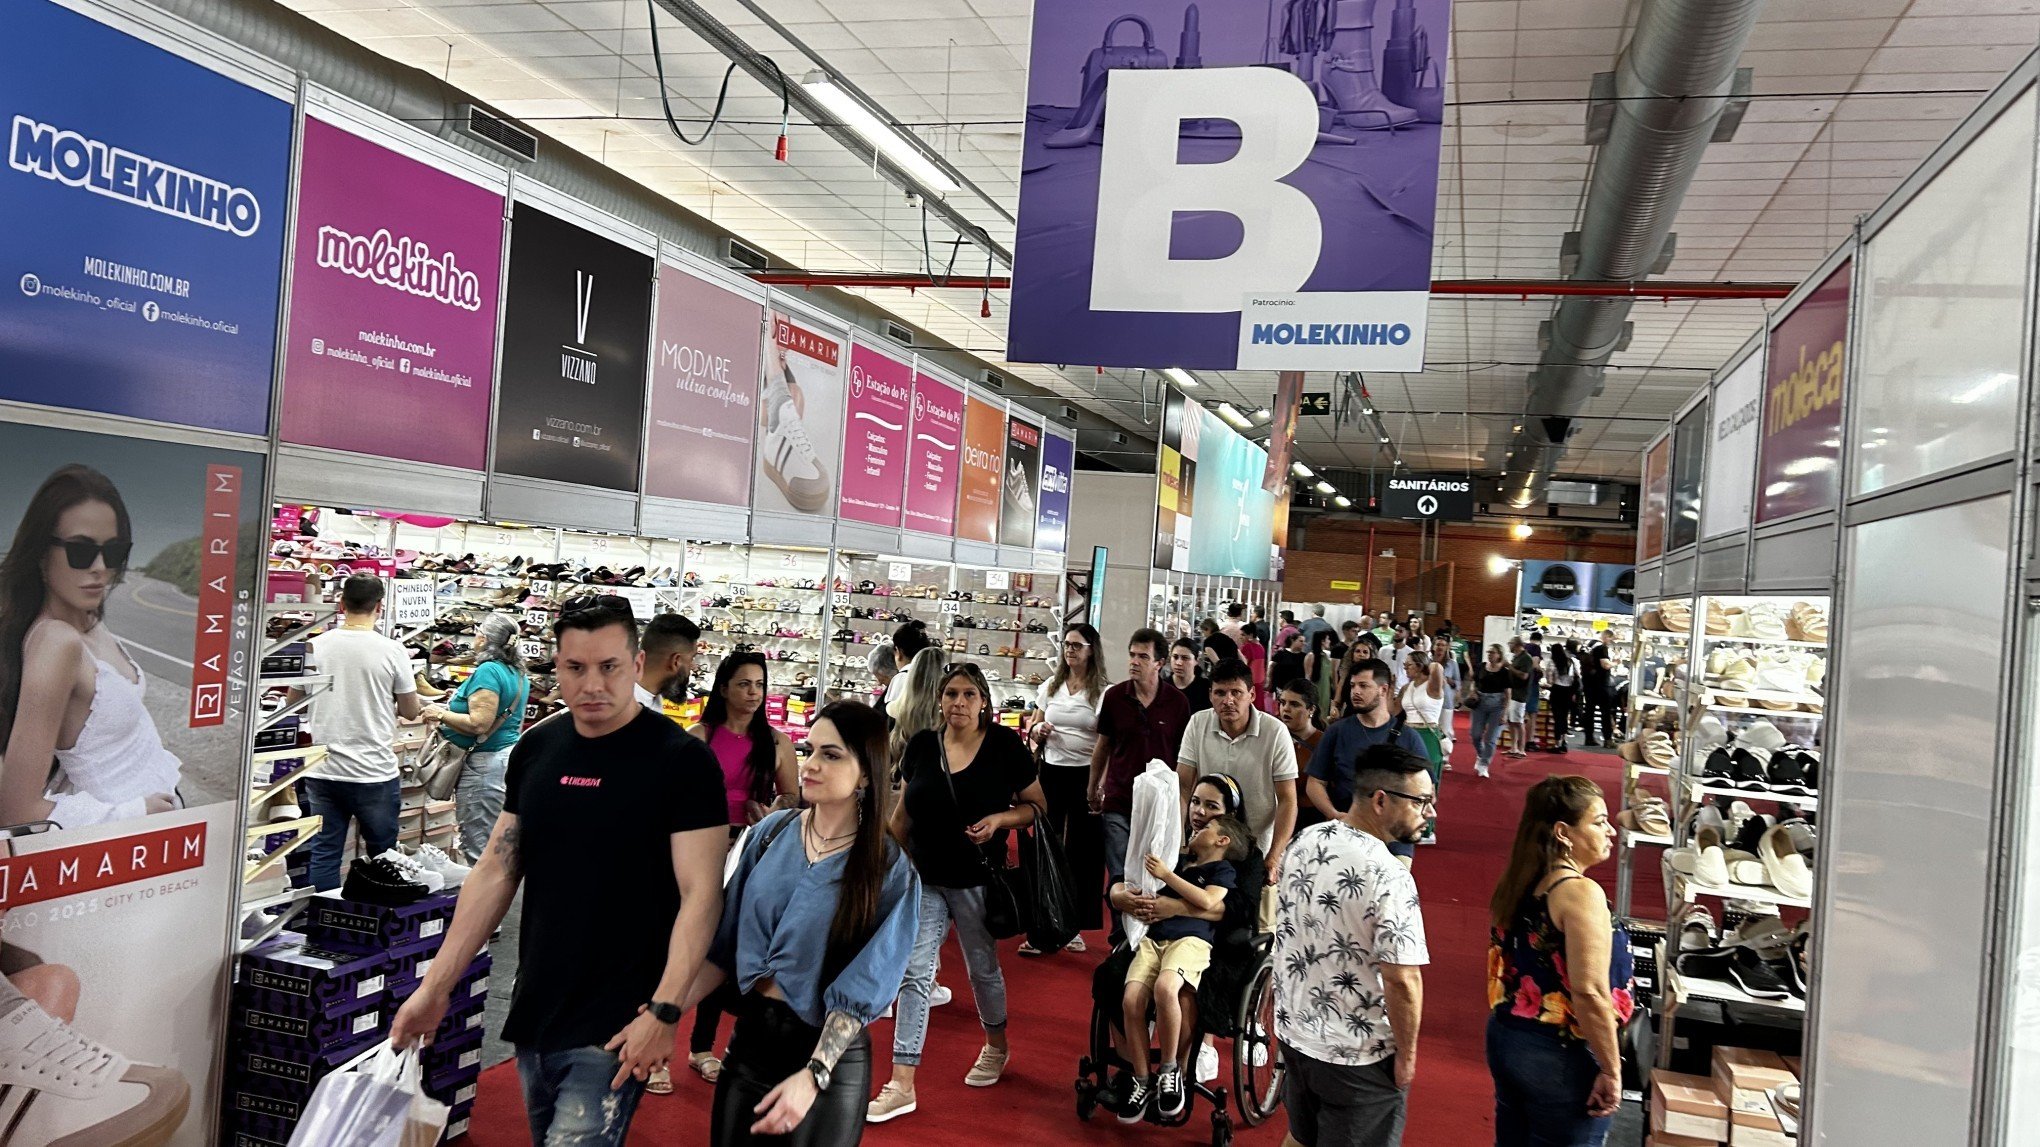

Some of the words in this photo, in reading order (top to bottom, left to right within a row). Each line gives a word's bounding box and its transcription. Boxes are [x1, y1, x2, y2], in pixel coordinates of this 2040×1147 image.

[9, 115, 260, 237] MOLEKINHO
[1089, 66, 1322, 313] B
[84, 256, 190, 298] MOLEKINHO.COM.BR
[317, 225, 481, 311] molekinha
[42, 283, 137, 313] molekinho_oficial
[1252, 298, 1296, 306] Patrocínio:
[161, 309, 239, 335] molekinho.oficial
[1251, 323, 1411, 346] MOLEKINHO
[358, 330, 436, 357] molekinha.com.br
[779, 323, 838, 361] RAMARIM
[561, 353, 597, 385] VIZZANO
[661, 339, 732, 385] MODARE
[866, 374, 891, 396] Estação
[891, 384, 900, 399] do
[899, 387, 908, 402] Pé
[1767, 341, 1843, 437] moleca
[964, 438, 989, 470] beira
[989, 449, 1000, 474] rio
[1388, 479, 1469, 492] SANITÁRIOS
[591, 538, 607, 552] 38
[783, 553, 797, 567] 36
[194, 473, 234, 719] RAMARIM
[397, 584, 433, 593] CHINELOS
[533, 582, 548, 593] 34
[732, 586, 746, 596] 36
[834, 594, 849, 604] 35
[402, 596, 427, 606] NUVEN
[943, 603, 958, 612] 34
[236, 590, 249, 639] 2025
[528, 612, 545, 624] 35
[522, 643, 539, 655] 36
[229, 650, 245, 719] VERÃO
[662, 703, 680, 711] oleca
[50, 898, 98, 922] 2025
[104, 893, 133, 908] CITY
[139, 887, 154, 899] TO
[160, 879, 198, 896] BEACH
[254, 972, 307, 991] RAMARIM
